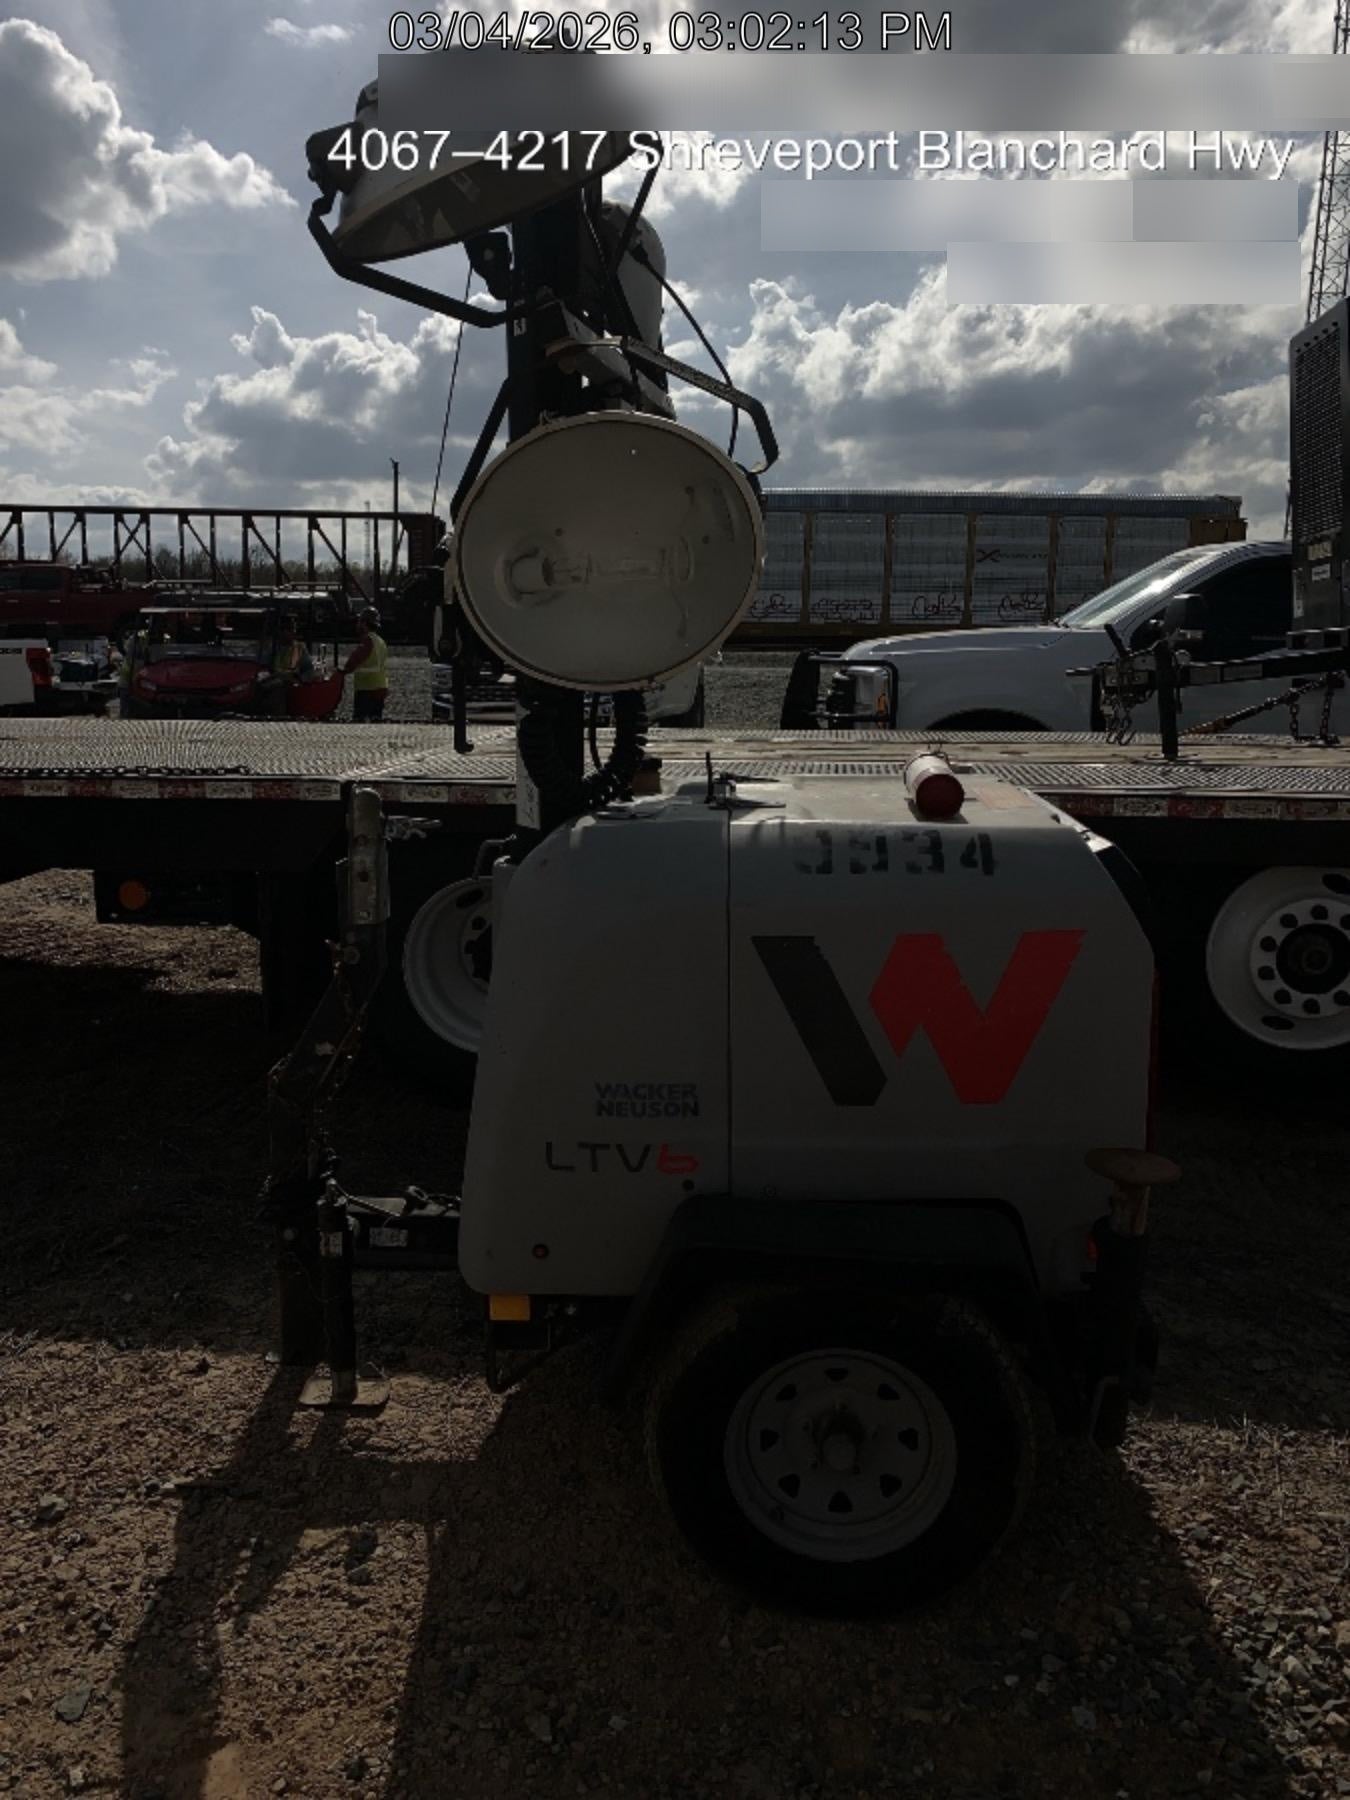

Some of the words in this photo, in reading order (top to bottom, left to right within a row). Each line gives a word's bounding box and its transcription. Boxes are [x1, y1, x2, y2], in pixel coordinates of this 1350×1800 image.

[594, 1082, 699, 1100] WACKER
[596, 1101, 699, 1118] NEUSON
[545, 1140, 699, 1174] LTV6
